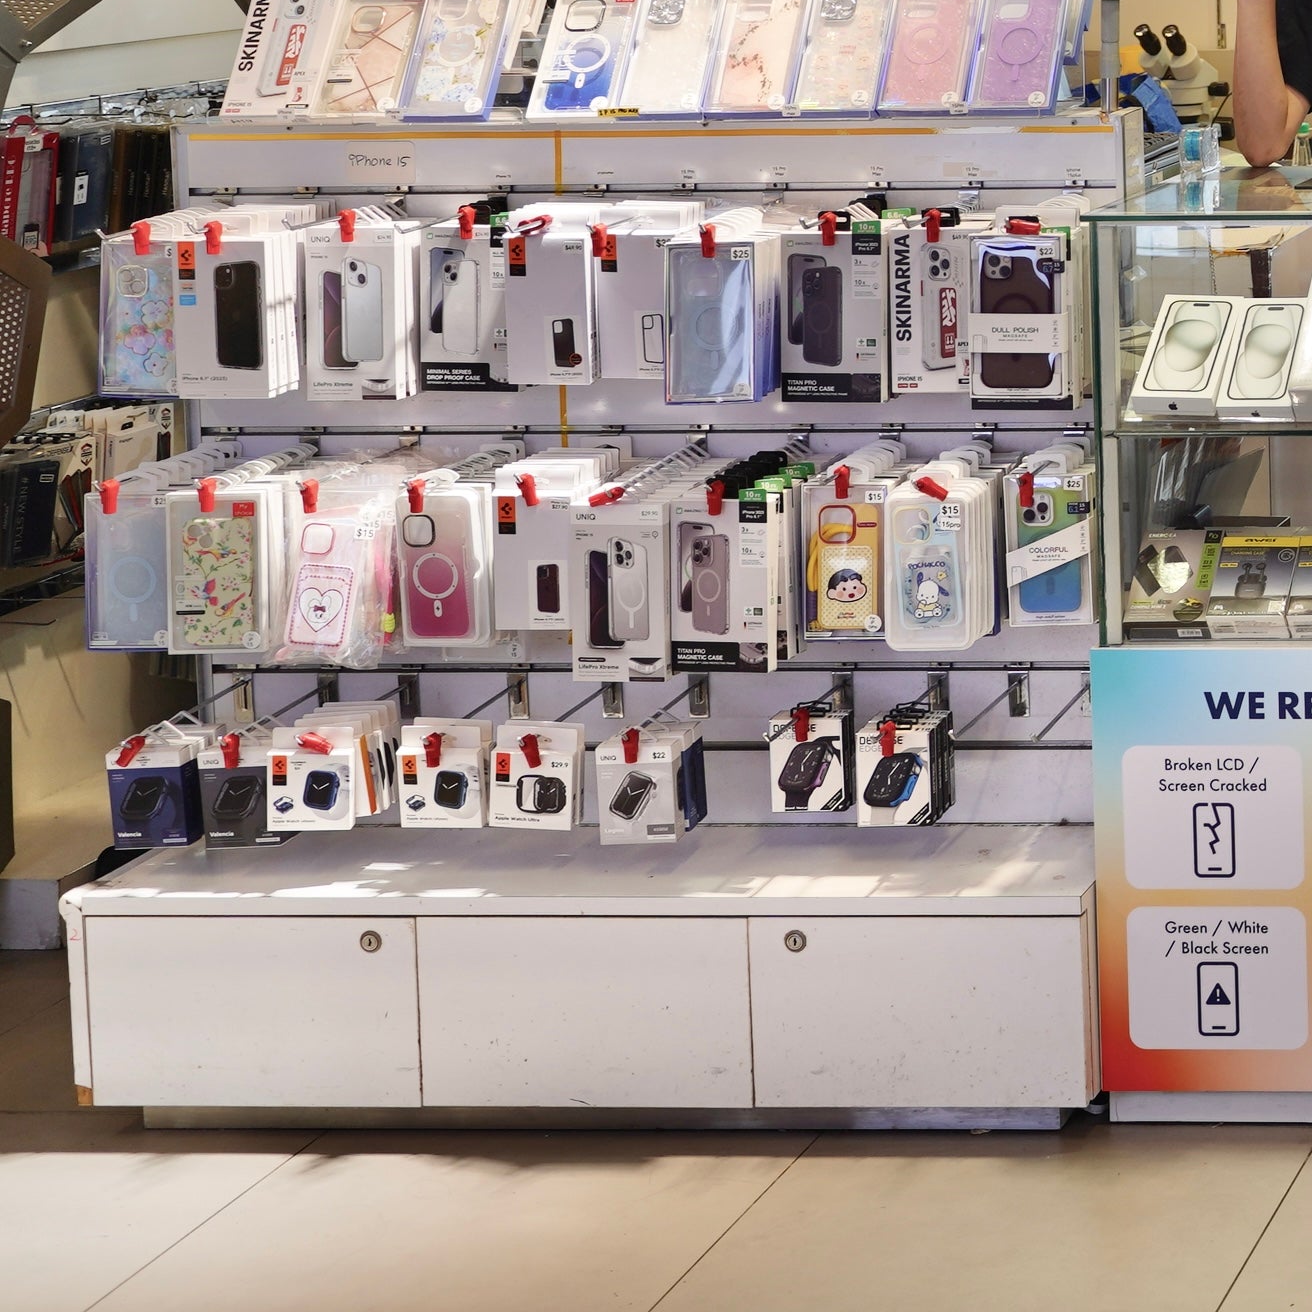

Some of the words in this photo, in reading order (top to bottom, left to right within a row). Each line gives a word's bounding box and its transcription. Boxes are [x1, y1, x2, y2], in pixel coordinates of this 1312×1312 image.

[348, 152, 395, 168] iPhone
[397, 154, 411, 168] 15
[310, 235, 331, 244] UNIQ
[732, 249, 750, 260] $25
[1038, 247, 1054, 256] $22
[895, 233, 912, 343] SKINARMA
[1066, 479, 1081, 489] $25
[941, 505, 959, 515] $15
[1028, 545, 1069, 554] COLORFUL
[1203, 691, 1265, 720] WE
[652, 751, 667, 760] $22
[1163, 757, 1212, 772] Broken
[1216, 757, 1245, 772] LCD
[1158, 778, 1206, 793] Screen
[1209, 778, 1267, 793] Cracked
[1164, 920, 1208, 935] Green
[1228, 920, 1269, 935] White
[1181, 941, 1218, 955] Black
[1223, 941, 1269, 955] Screen
